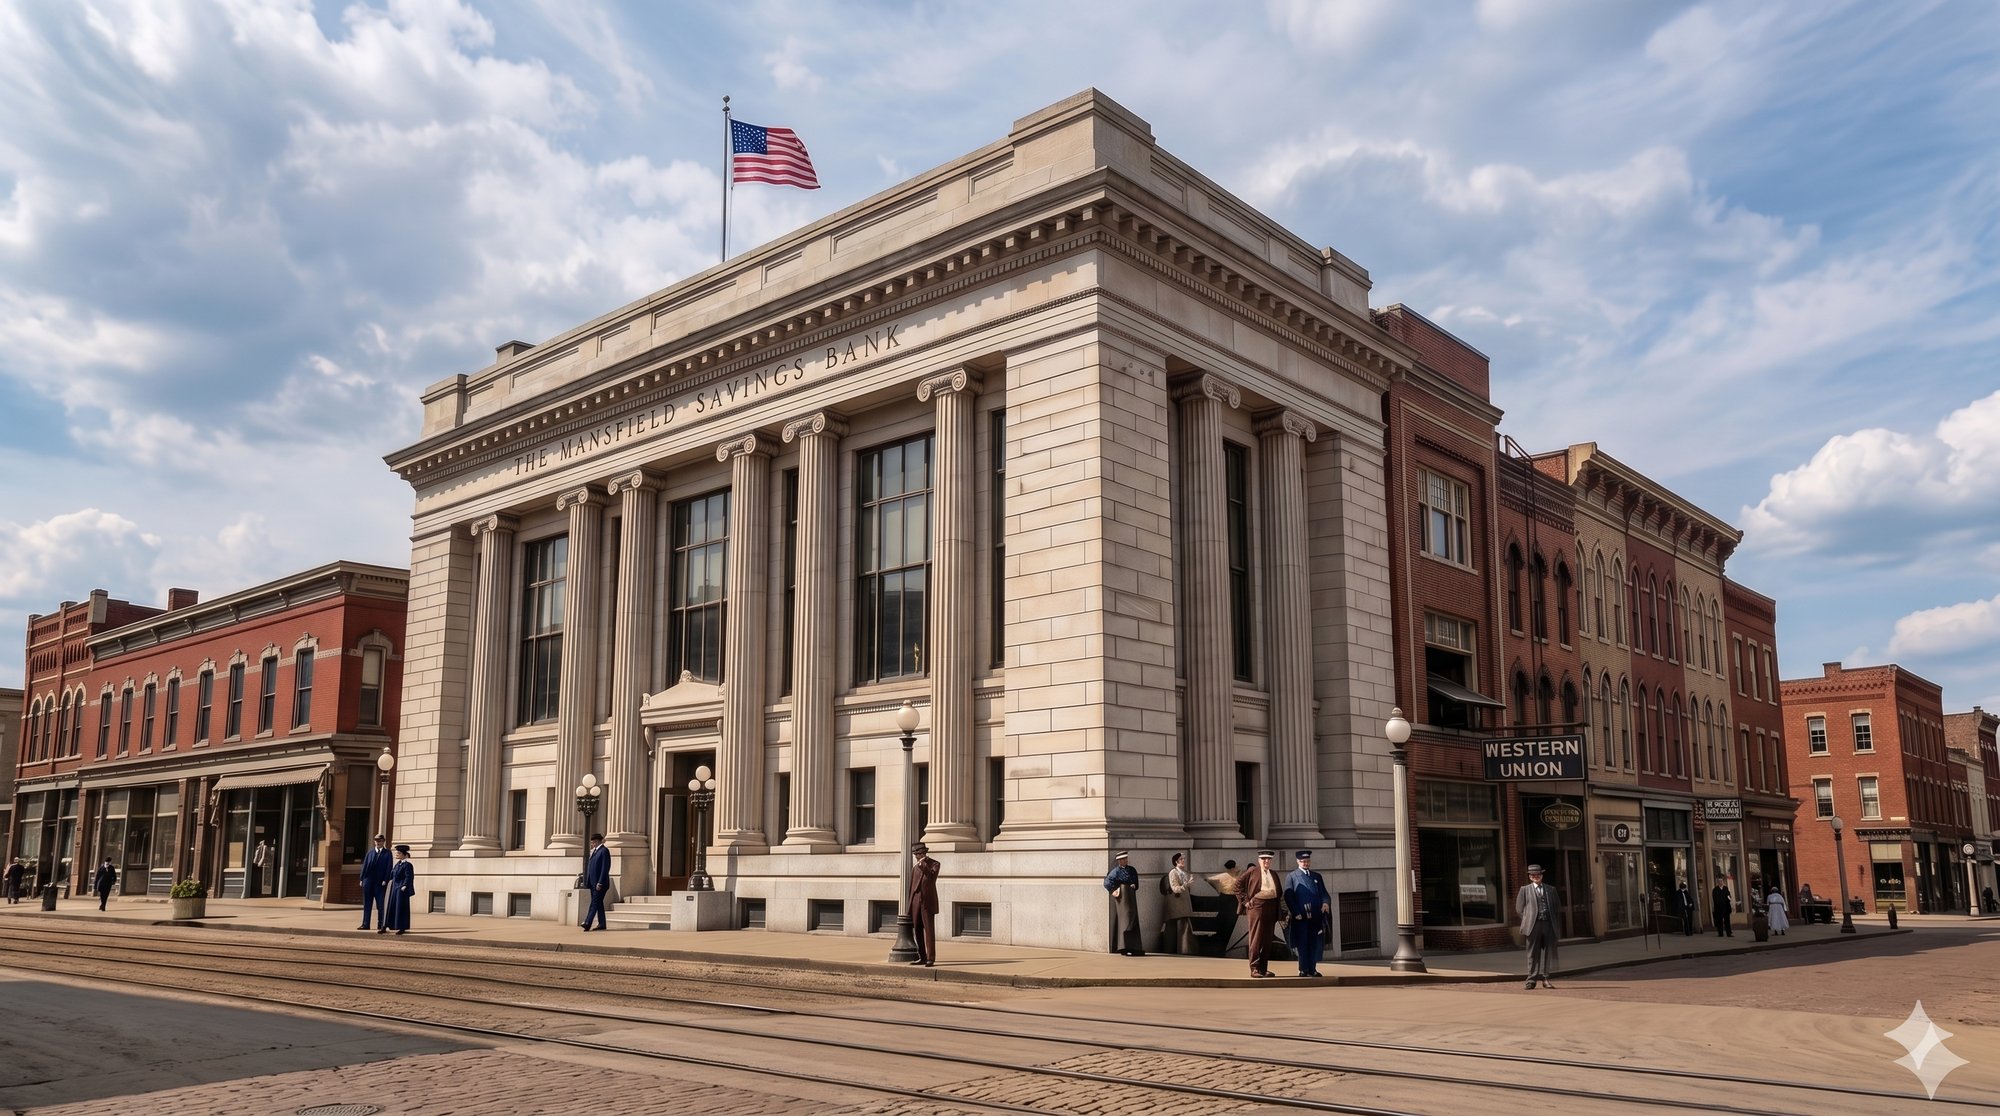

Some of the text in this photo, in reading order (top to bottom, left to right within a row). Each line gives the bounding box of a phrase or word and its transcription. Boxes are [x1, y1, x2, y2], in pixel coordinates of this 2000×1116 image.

[514, 323, 902, 476] THE MANSFIELD SAVINGS BANK
[1485, 740, 1579, 758] WESTERN
[1500, 761, 1563, 778] UNION
